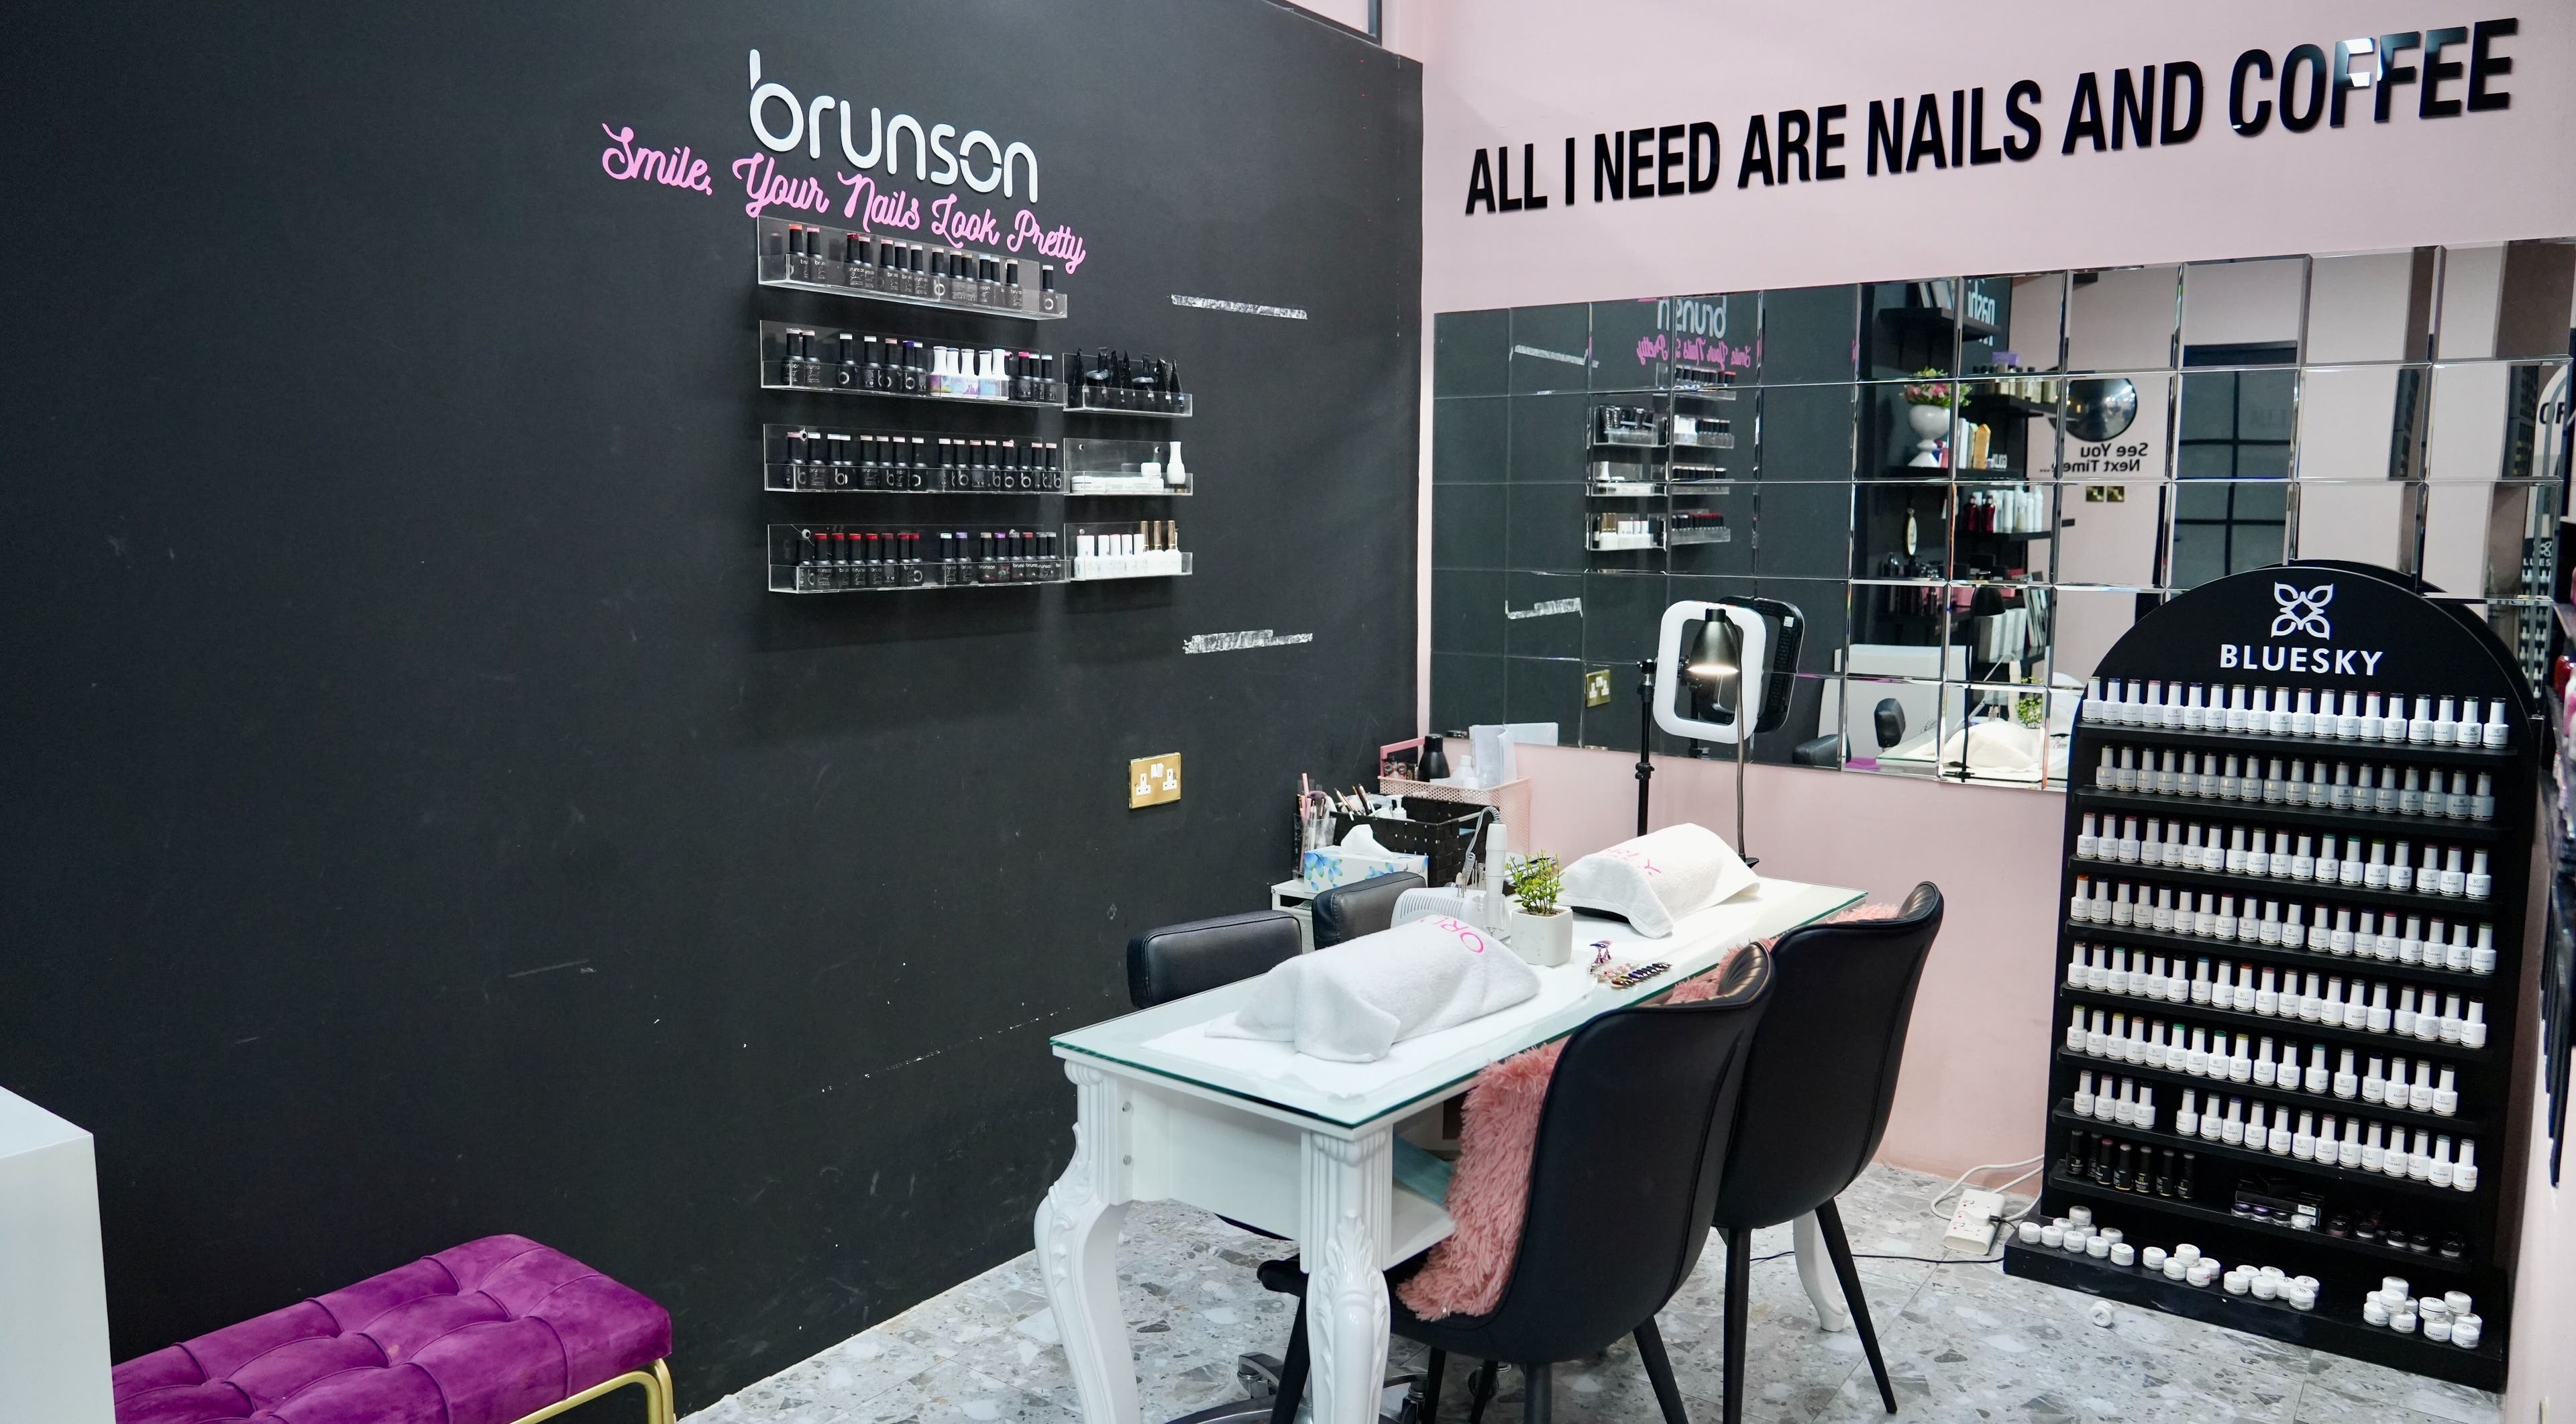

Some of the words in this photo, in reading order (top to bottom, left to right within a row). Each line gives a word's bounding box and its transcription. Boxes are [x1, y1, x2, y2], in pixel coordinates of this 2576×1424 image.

[749, 49, 1038, 203] brunson
[1465, 144, 1548, 216] ALL
[1565, 137, 1576, 207] I
[1594, 121, 1721, 203] NEED
[1737, 103, 1847, 189] ARE
[1867, 79, 2042, 177] NAILS
[2061, 60, 2204, 156] AND
[2229, 17, 2519, 138] COFFEE
[602, 123, 713, 196] Smile,
[732, 152, 829, 217] Your
[838, 171, 920, 232] Nails
[932, 193, 1000, 248] Look
[1008, 209, 1086, 272] Pretty
[2220, 644, 2383, 676] BLUESKY
